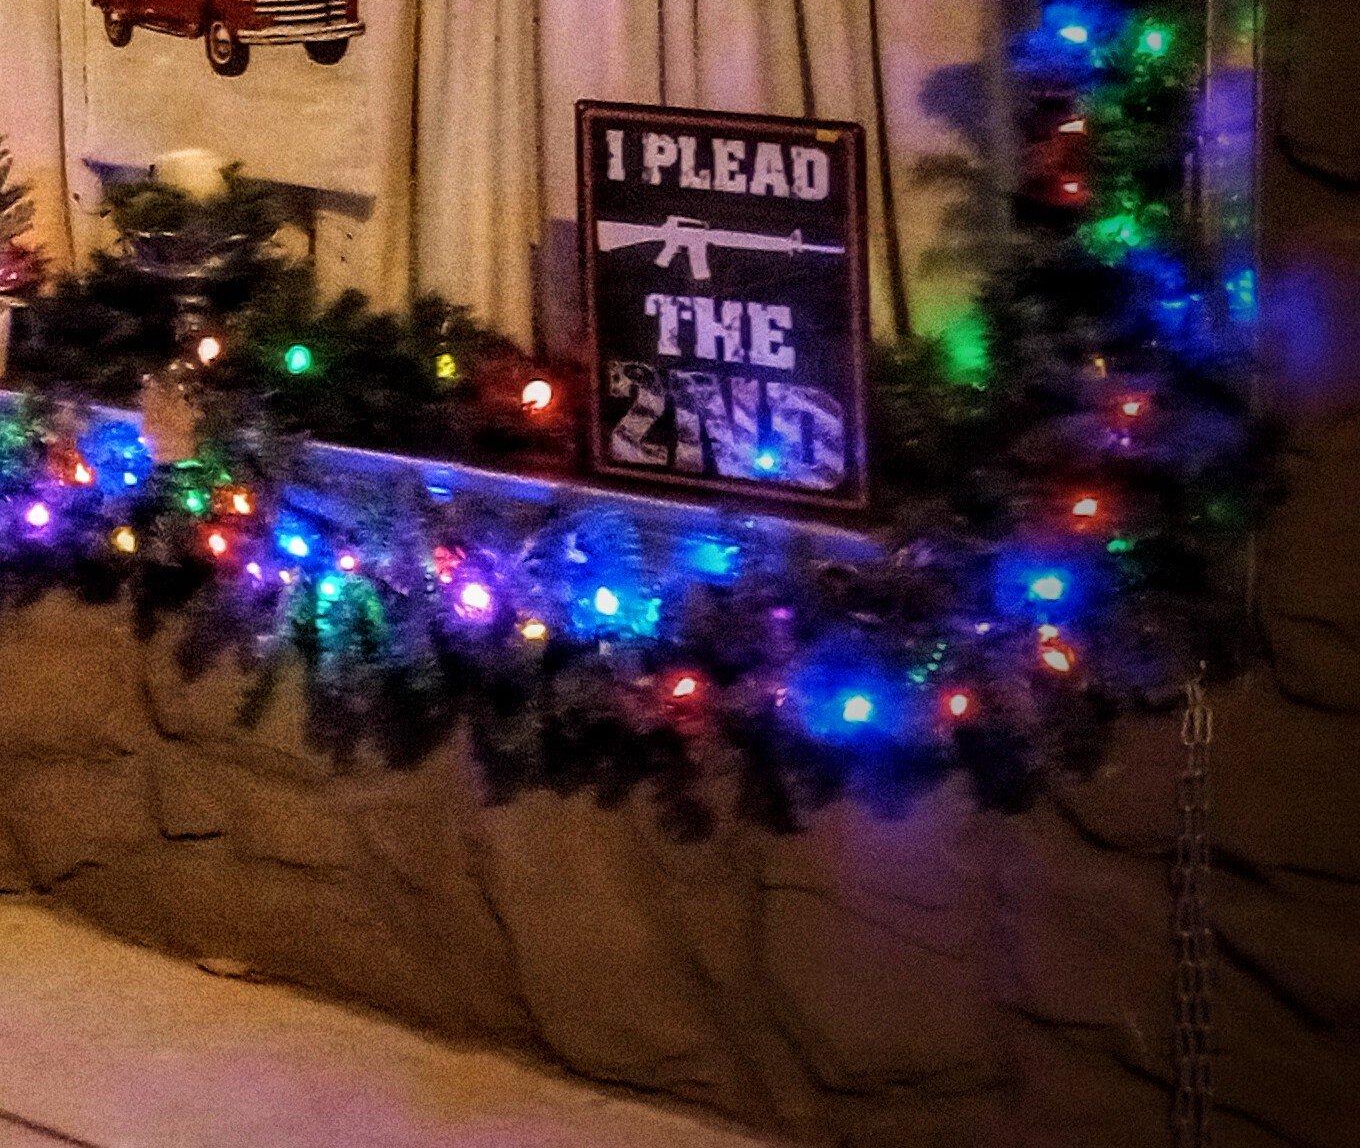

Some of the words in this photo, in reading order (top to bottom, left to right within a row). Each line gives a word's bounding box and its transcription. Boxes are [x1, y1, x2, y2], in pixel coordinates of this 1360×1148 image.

[605, 129, 626, 182] I
[642, 132, 830, 201] PLEAD
[644, 292, 796, 370] THE
[607, 359, 846, 491] 2ND
